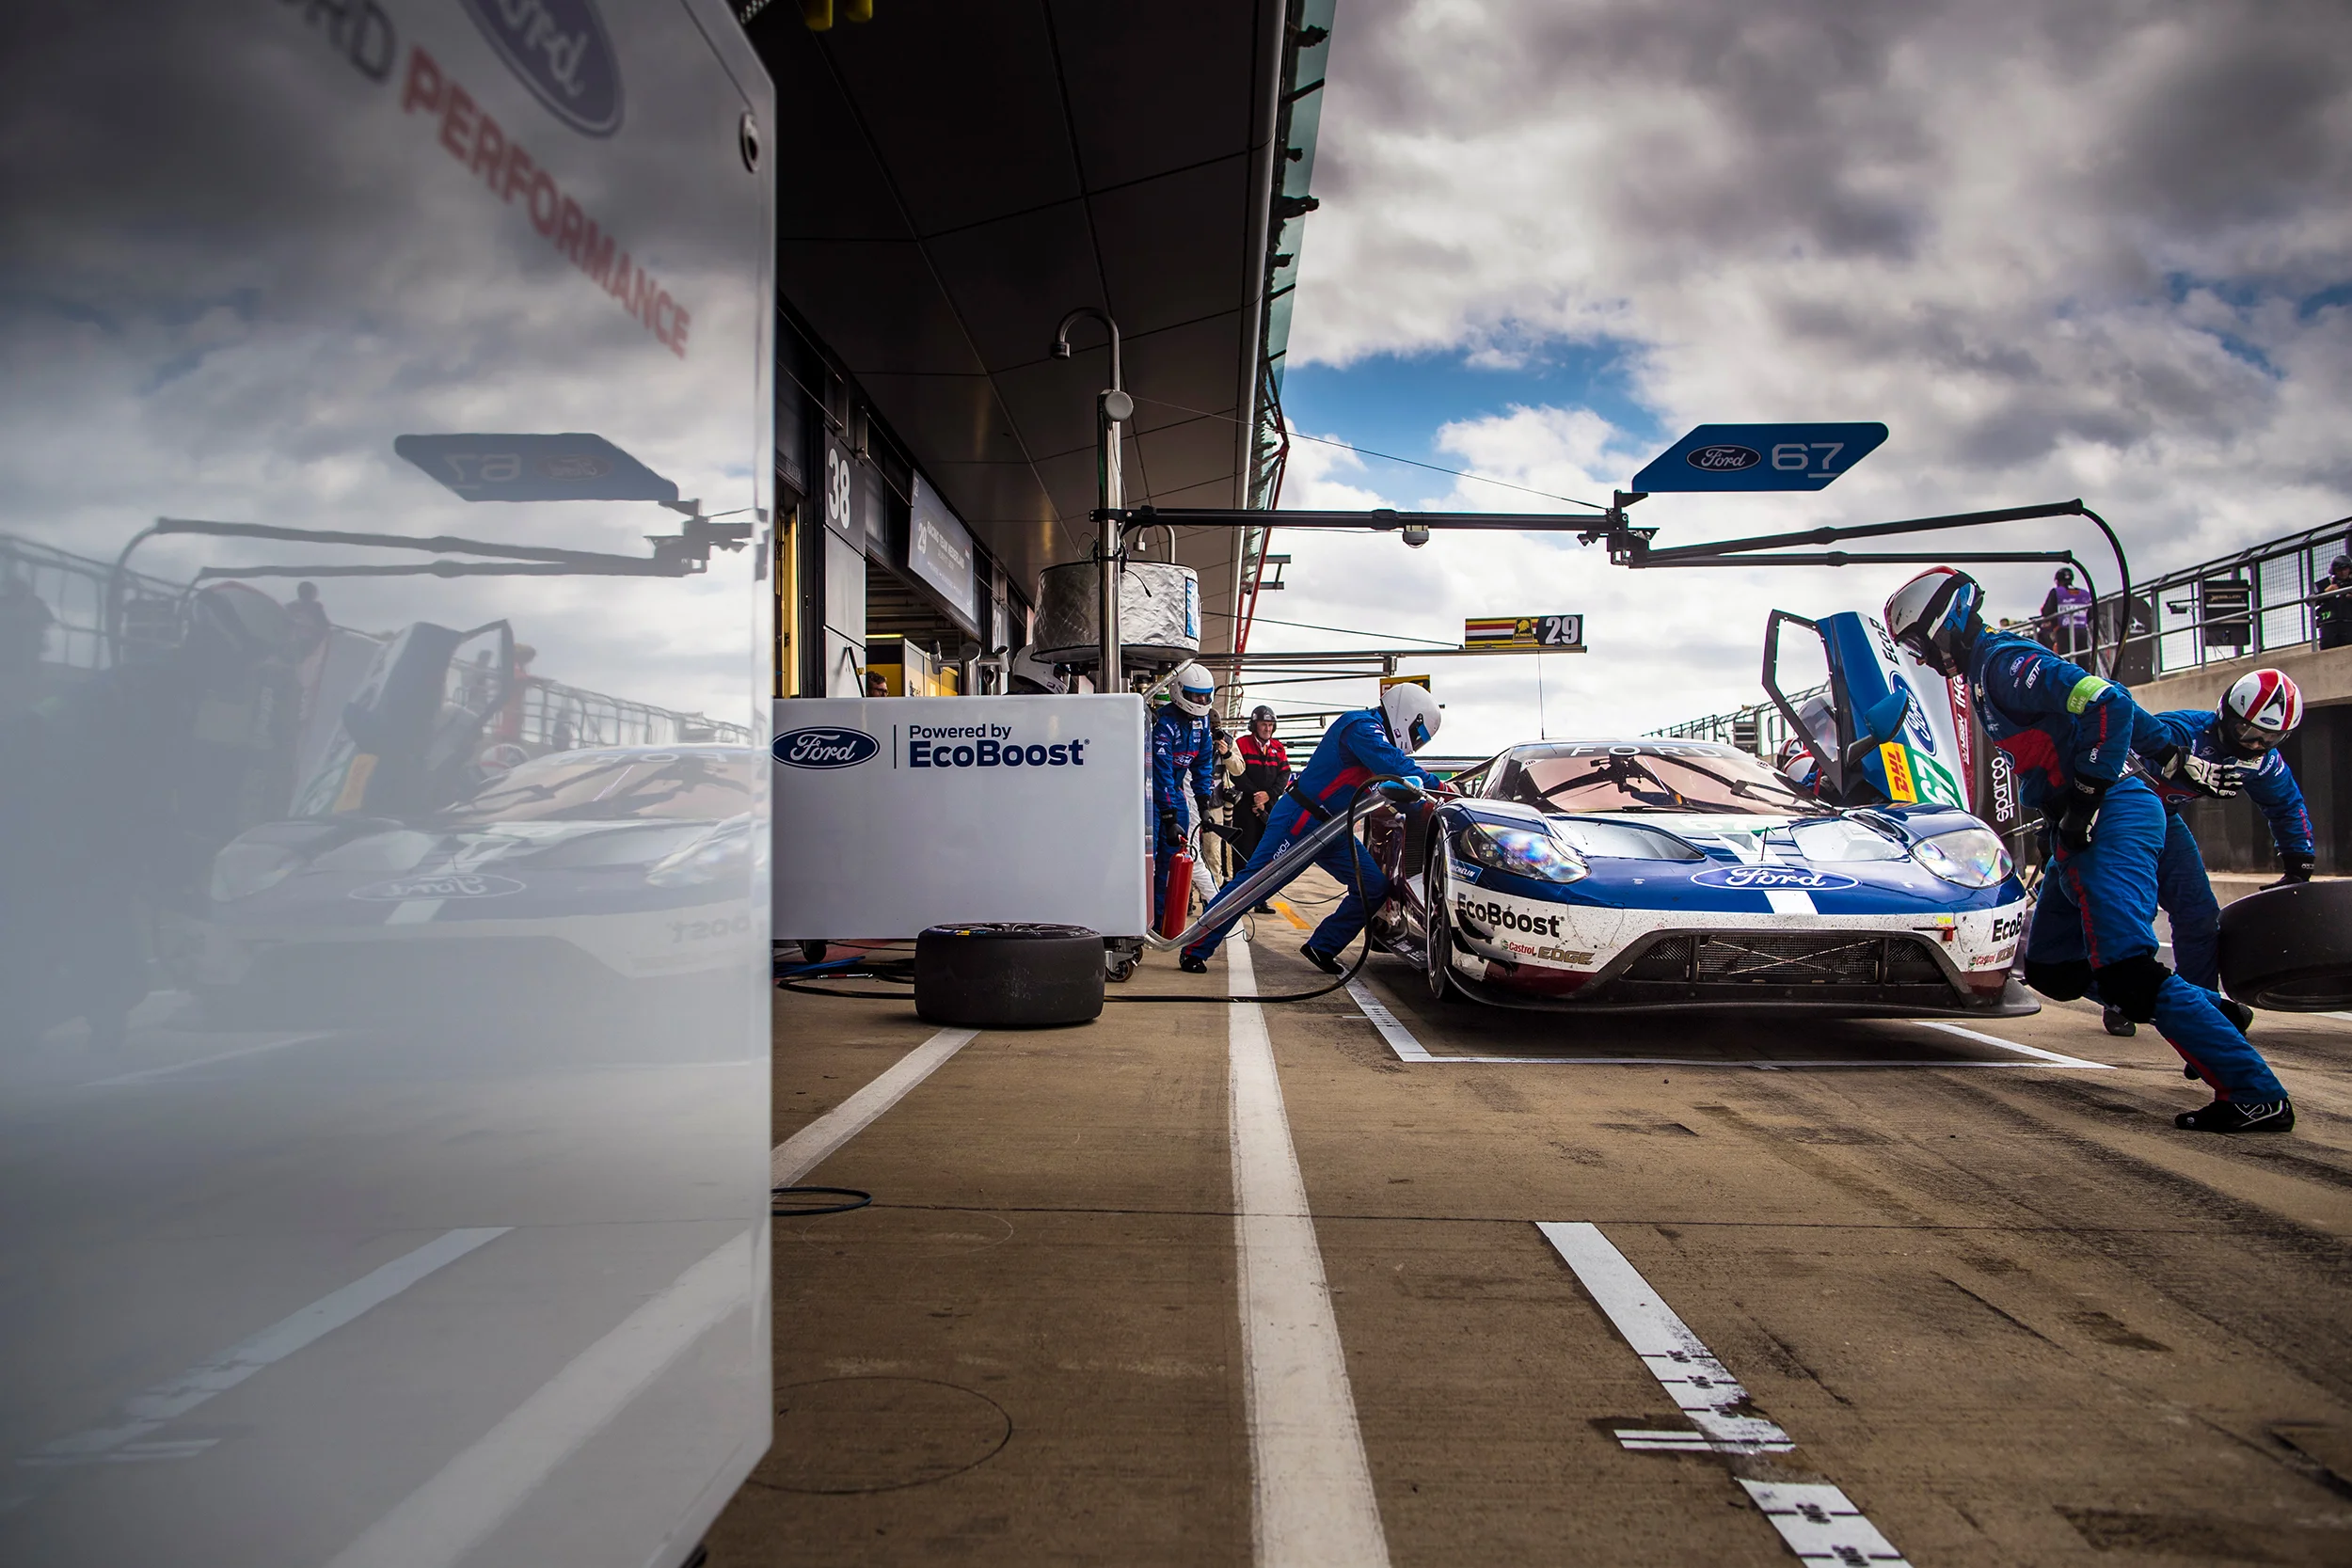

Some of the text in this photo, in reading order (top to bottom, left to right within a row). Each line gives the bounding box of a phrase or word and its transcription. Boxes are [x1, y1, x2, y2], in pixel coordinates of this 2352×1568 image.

[403, 45, 691, 359] PERFORMANCE
[1701, 443, 1844, 470] Ford 67
[828, 448, 850, 530] 38
[917, 522, 928, 555] 29
[1545, 616, 1579, 645] 29
[2070, 695, 2078, 708] PIT
[910, 723, 1011, 739] Powered by
[790, 733, 855, 762] Ford
[910, 738, 1085, 768] EcoBoost
[1570, 746, 1723, 758] FORD
[1887, 751, 1910, 795] DHL
[1992, 756, 2014, 823] sparco
[1725, 866, 1827, 888] Ford
[1457, 893, 1561, 939] EcoBoost
[1508, 942, 1596, 966] Castrol EDGE
